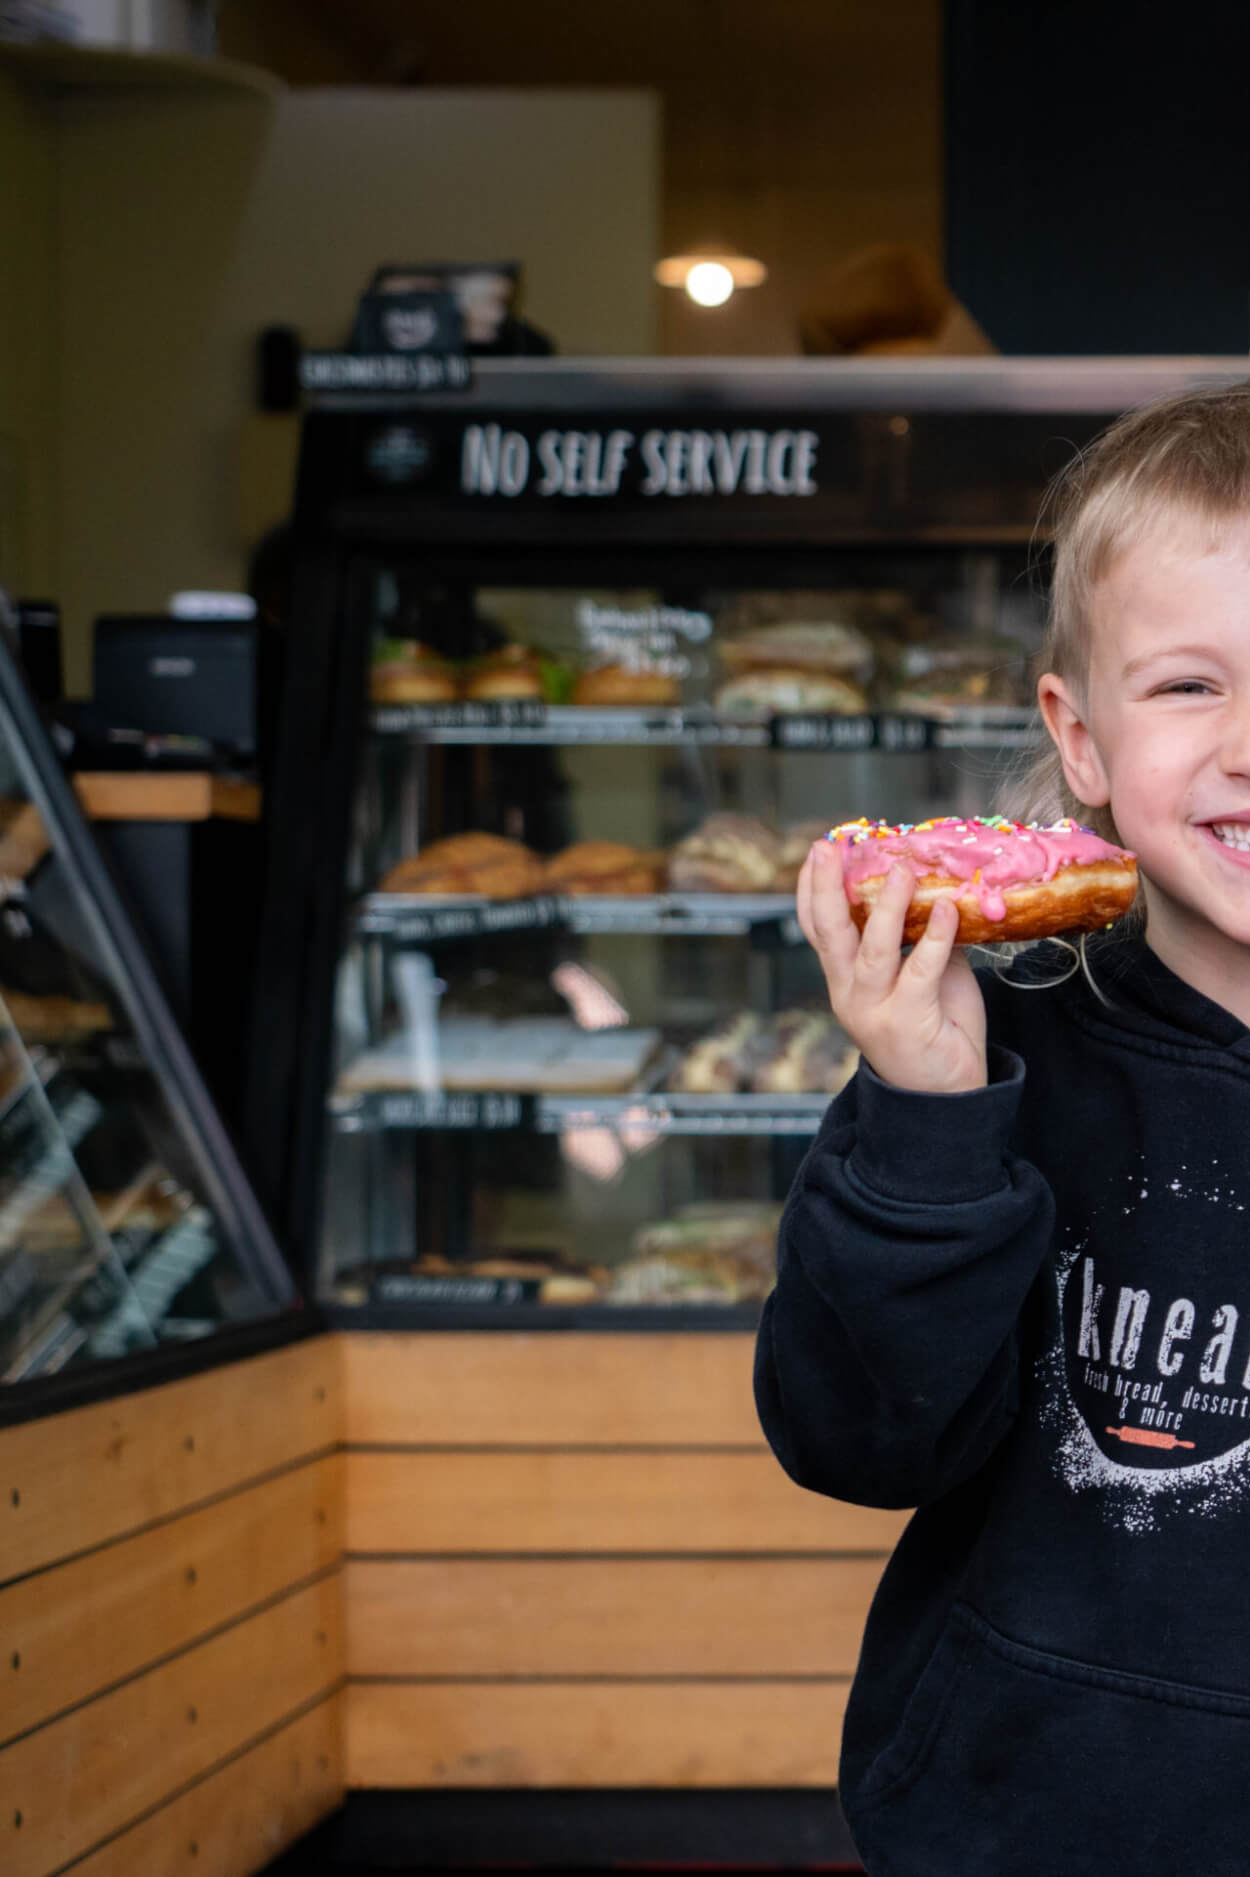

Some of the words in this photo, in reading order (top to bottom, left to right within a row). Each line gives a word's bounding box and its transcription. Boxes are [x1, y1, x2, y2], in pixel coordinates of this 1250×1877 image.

[461, 423, 529, 497] No
[536, 429, 634, 497] SELF
[641, 429, 819, 496] SERVICE
[1114, 1373, 1168, 1408] bread,
[1118, 1397, 1129, 1419] &
[1140, 1406, 1184, 1430] more
